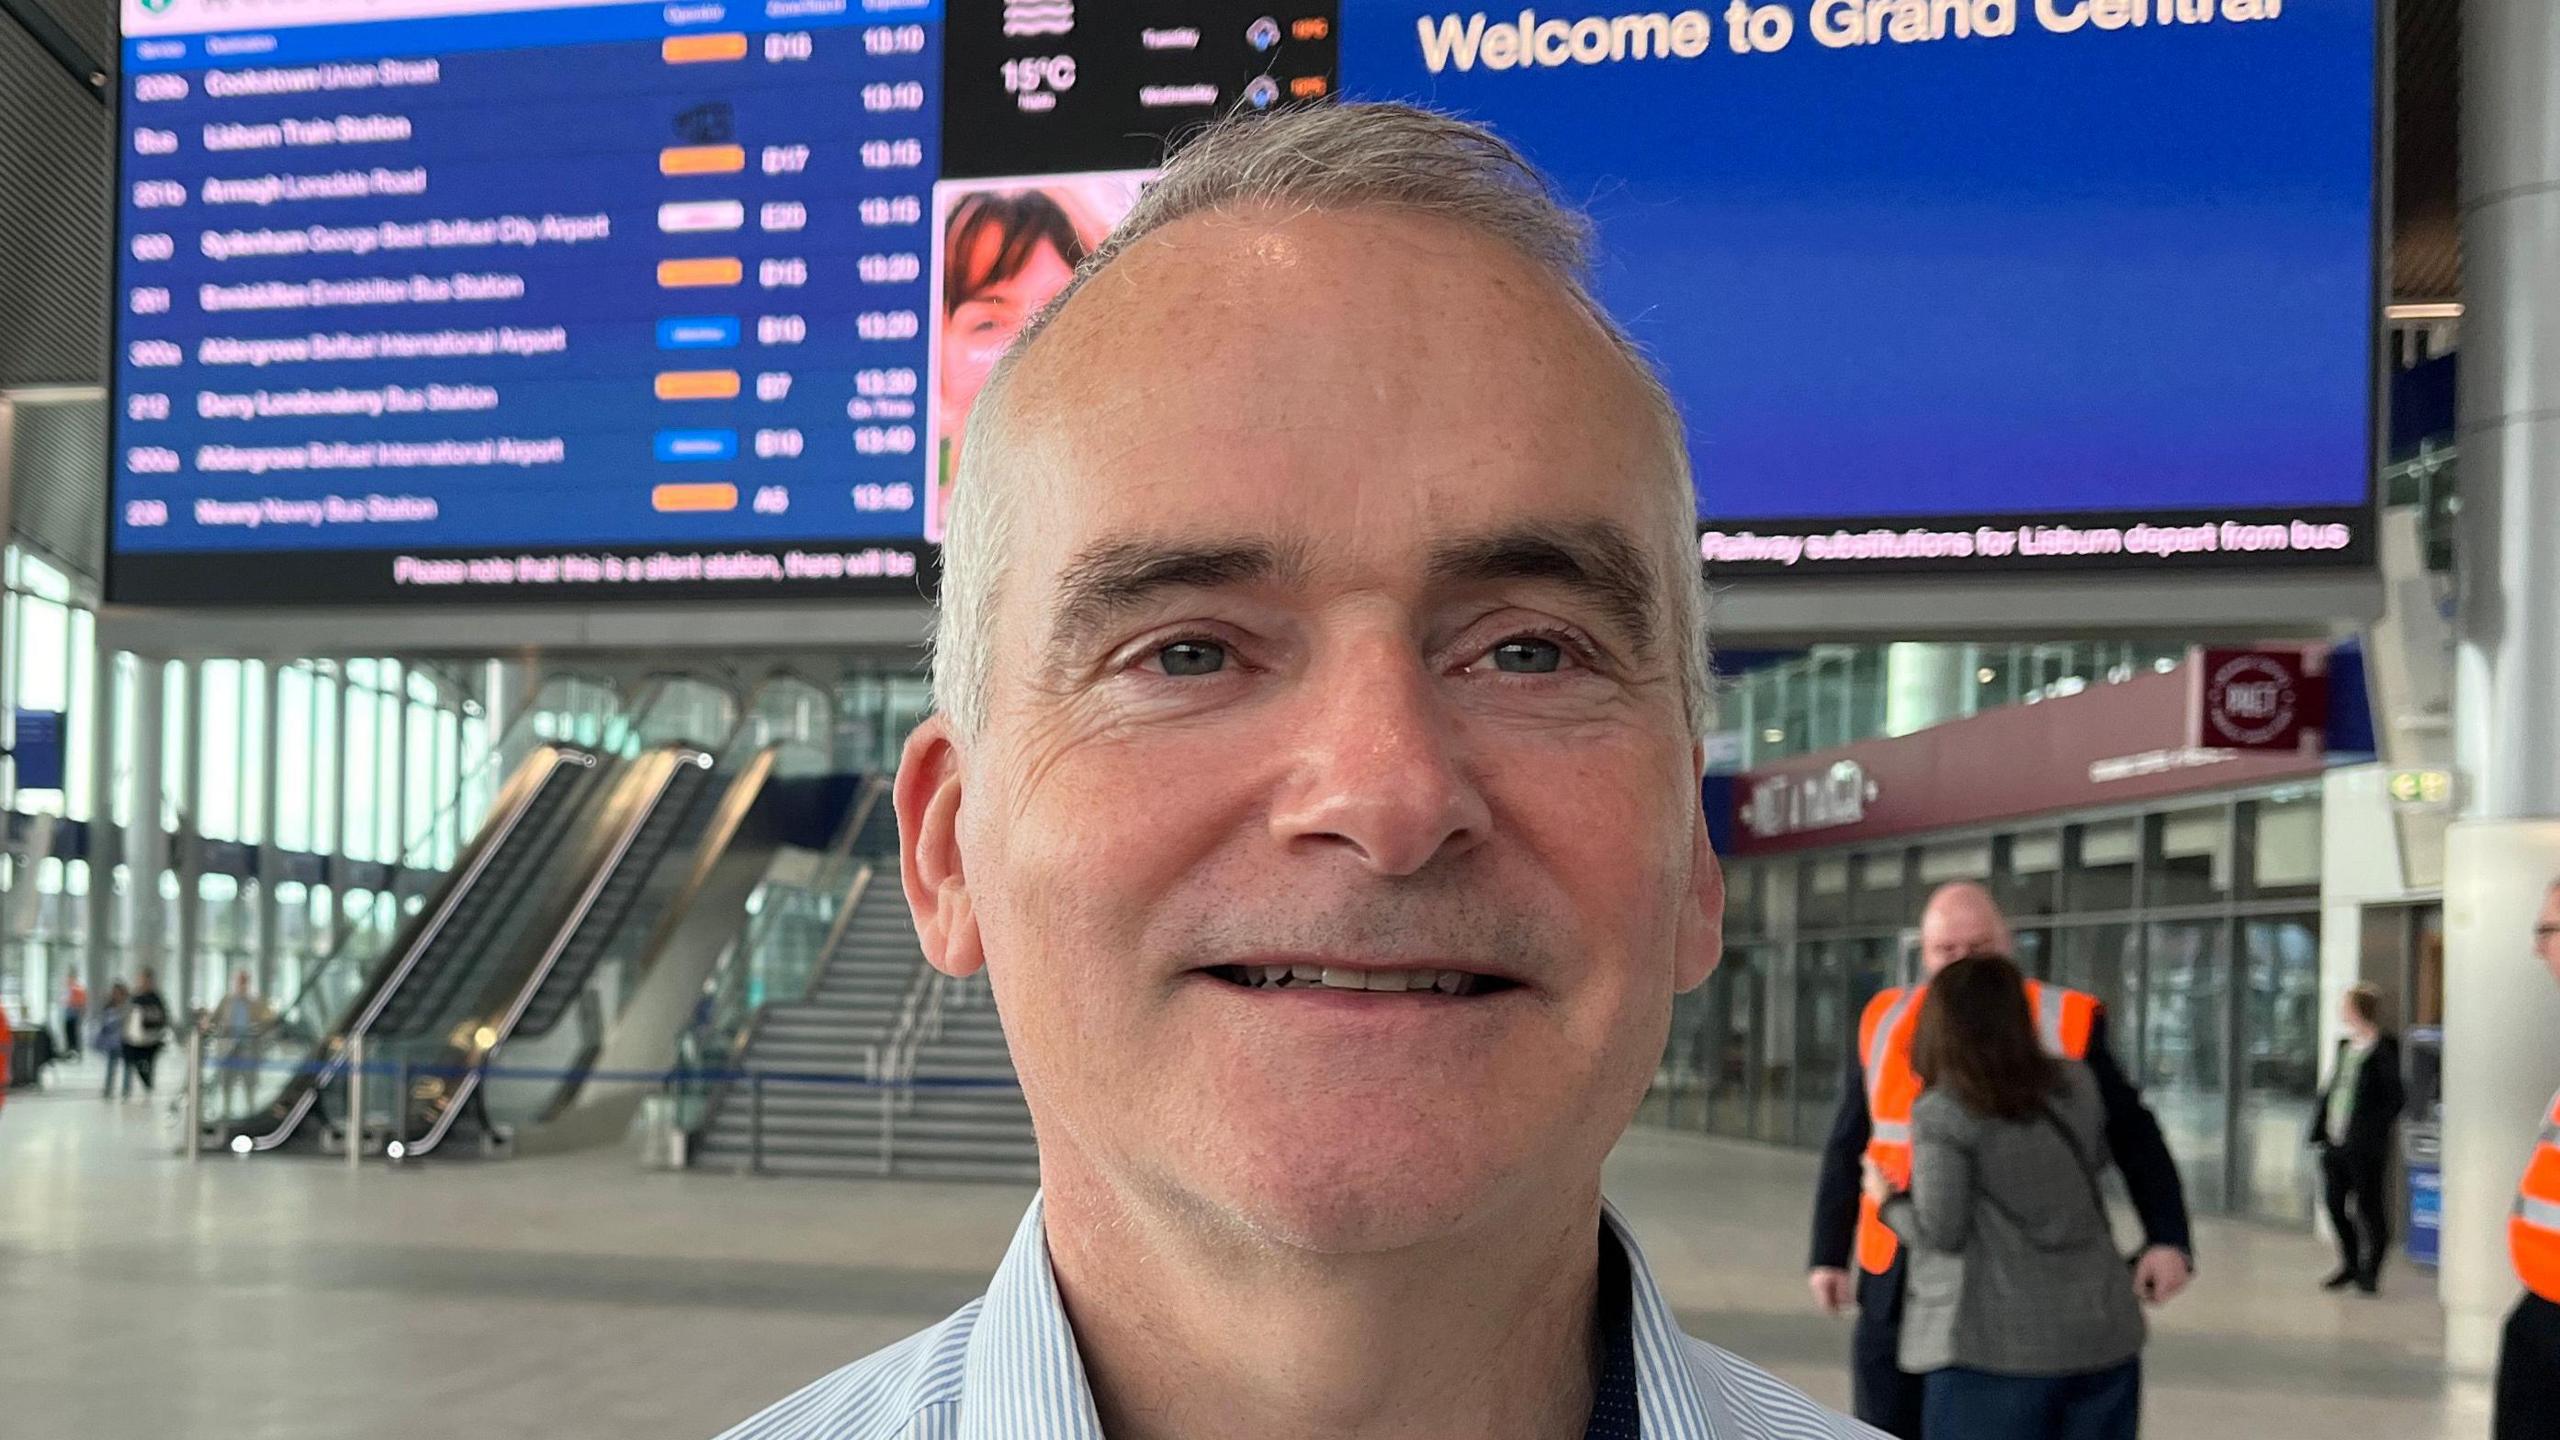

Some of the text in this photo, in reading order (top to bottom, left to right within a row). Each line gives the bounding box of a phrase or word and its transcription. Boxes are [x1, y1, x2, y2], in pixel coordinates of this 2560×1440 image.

[1417, 8, 1711, 73] Welcome
[1724, 0, 1794, 54] to
[1809, 0, 2016, 49] Grand
[1001, 54, 1076, 92] 15°C
[135, 128, 177, 154] Bus
[204, 124, 282, 150] Lisburn
[282, 120, 336, 144] Train
[336, 116, 411, 142] Station
[370, 169, 426, 193] Road
[308, 226, 378, 253] George
[378, 223, 427, 248] Best
[427, 220, 497, 245] Belfast
[497, 217, 537, 244] City
[537, 216, 609, 242] Airport
[409, 276, 451, 301] Bus
[451, 274, 524, 299] Station
[199, 339, 310, 366] Aldergrove
[310, 334, 378, 359] Belfast
[378, 332, 498, 356] International
[498, 328, 566, 354] Airport
[383, 386, 426, 412] Bus
[426, 385, 498, 410] Station
[197, 446, 308, 473] Aldergrove
[308, 442, 377, 468] Belfast
[377, 442, 496, 466] International
[496, 439, 563, 465] Airport
[324, 496, 367, 522] Bus
[367, 495, 438, 521] Station
[1803, 529, 1974, 559] substitutions
[1975, 527, 2017, 556] for
[2018, 526, 2122, 555] Lisburn
[2123, 523, 2219, 557] depart
[2220, 521, 2290, 551] from
[2290, 520, 2350, 550] bus
[394, 549, 915, 584] Please note that this is a silent station, there will be
